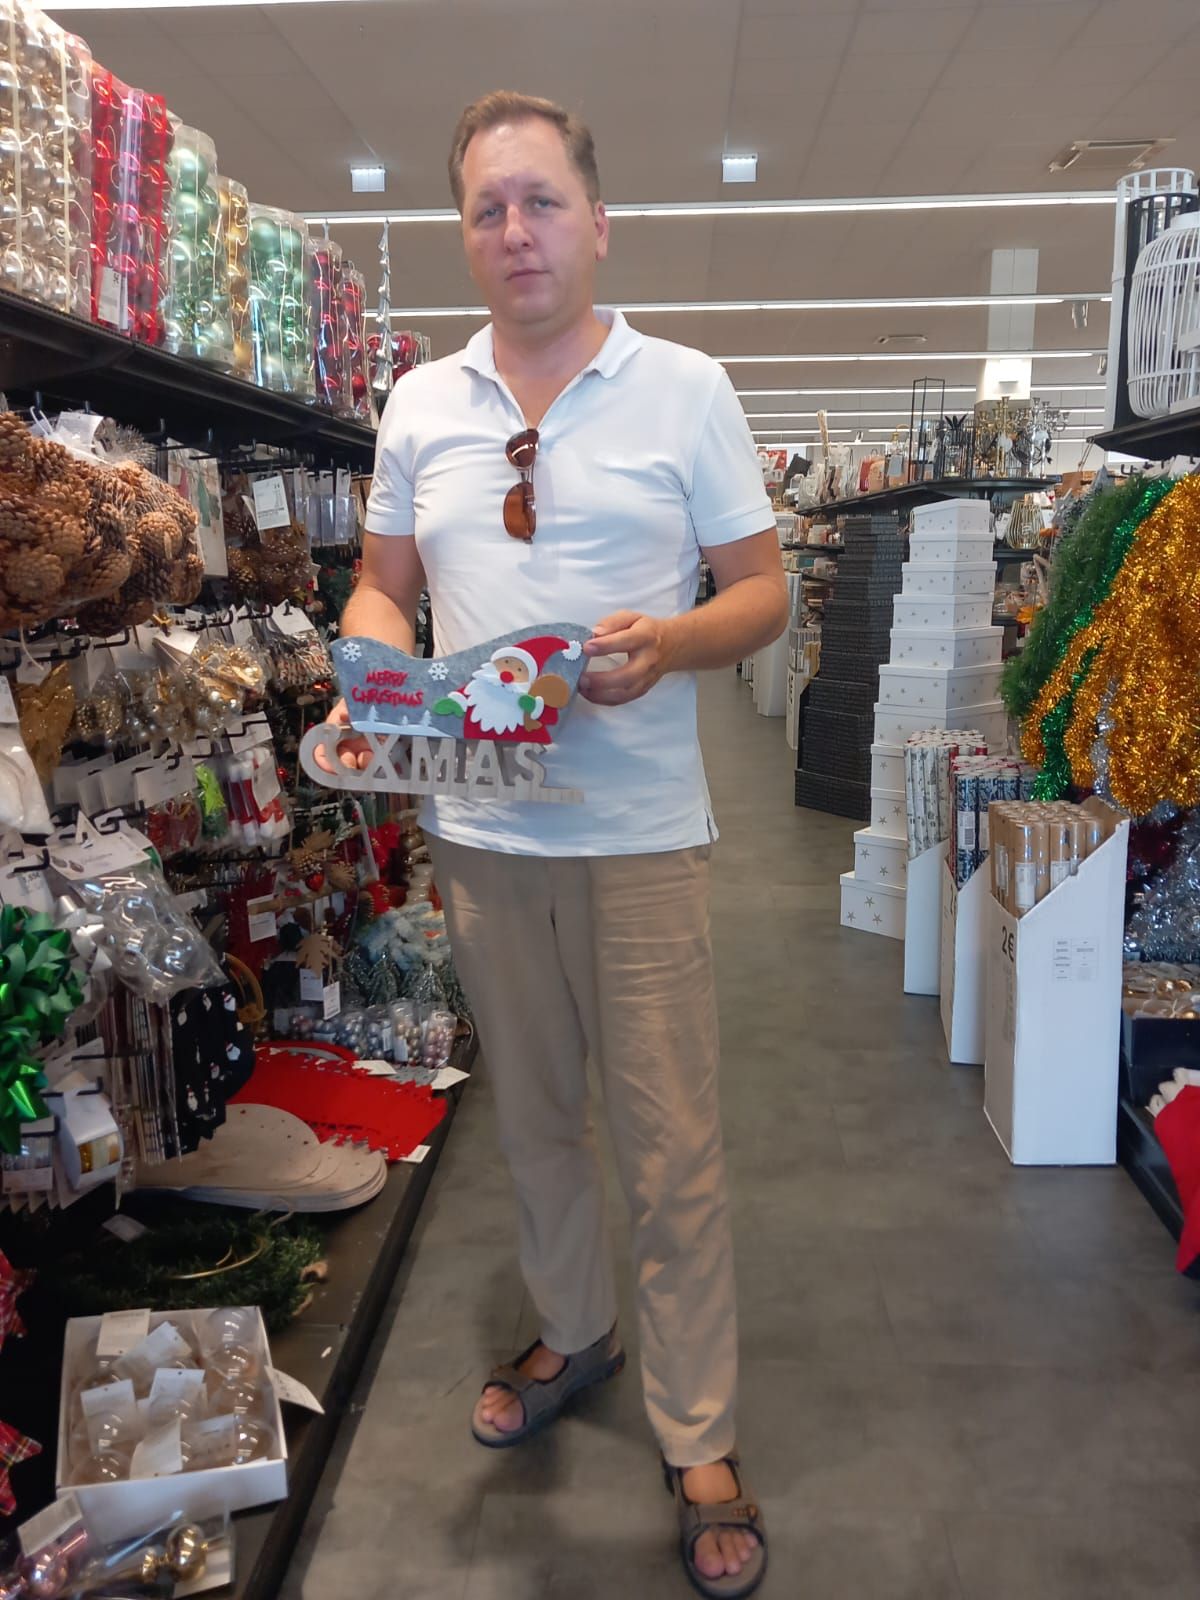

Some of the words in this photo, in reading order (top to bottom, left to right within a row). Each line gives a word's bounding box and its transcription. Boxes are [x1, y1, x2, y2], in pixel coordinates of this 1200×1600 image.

[366, 669, 408, 687] MERRY
[352, 687, 424, 707] CHRISTMAS
[361, 733, 546, 789] XMAS
[1002, 925, 1015, 962] 2€
